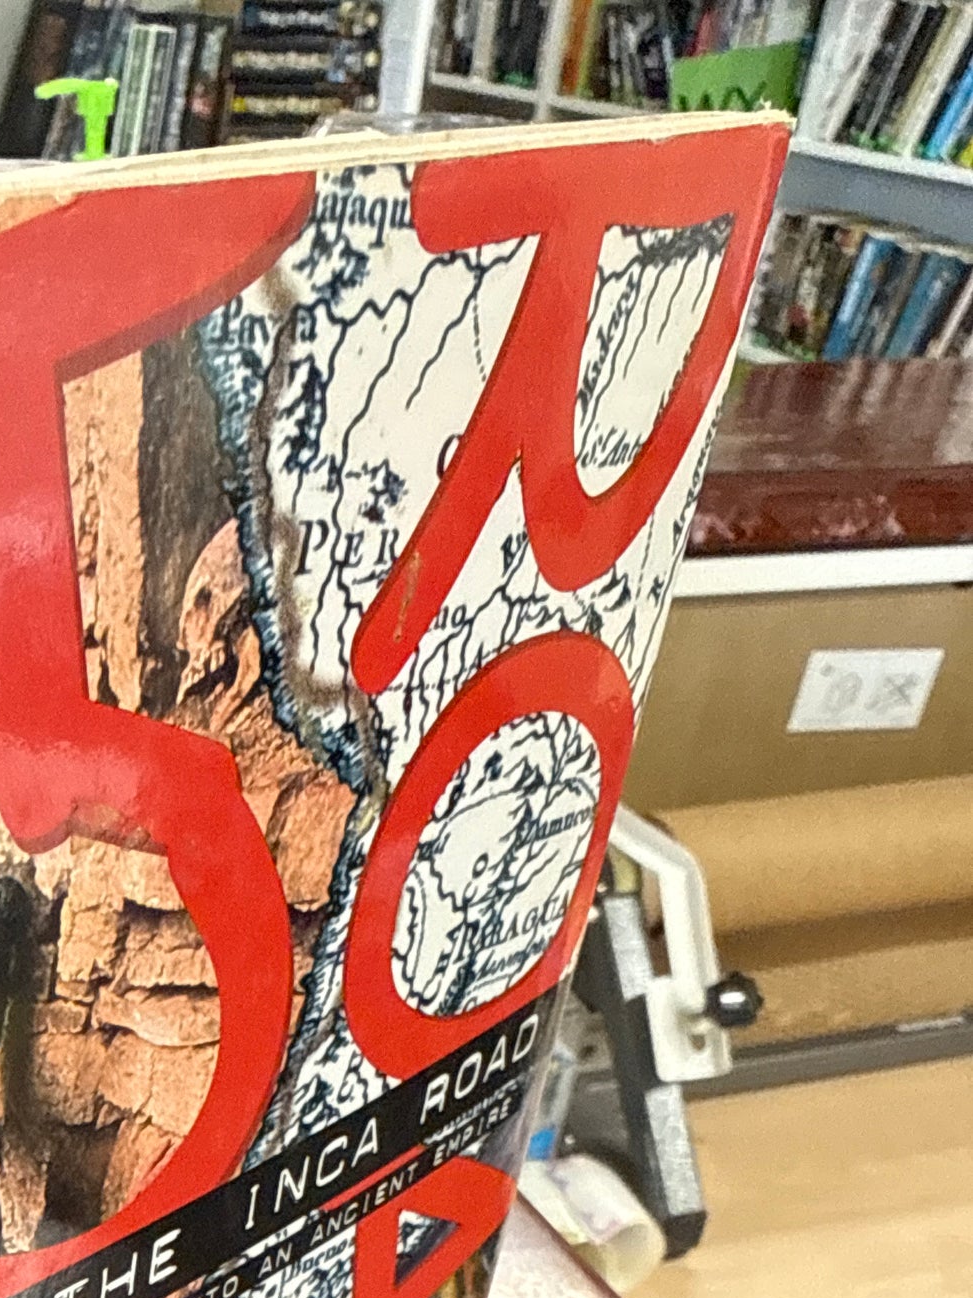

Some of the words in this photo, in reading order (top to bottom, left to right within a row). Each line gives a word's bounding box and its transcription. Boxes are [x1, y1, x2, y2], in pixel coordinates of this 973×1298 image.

[295, 519, 400, 577] PER
[244, 1116, 379, 1230] INCA
[419, 1013, 540, 1125] ROAD
[258, 1244, 294, 1277] AN
[310, 1163, 420, 1246] ANCIENT
[432, 1095, 513, 1167] EMPIRE
